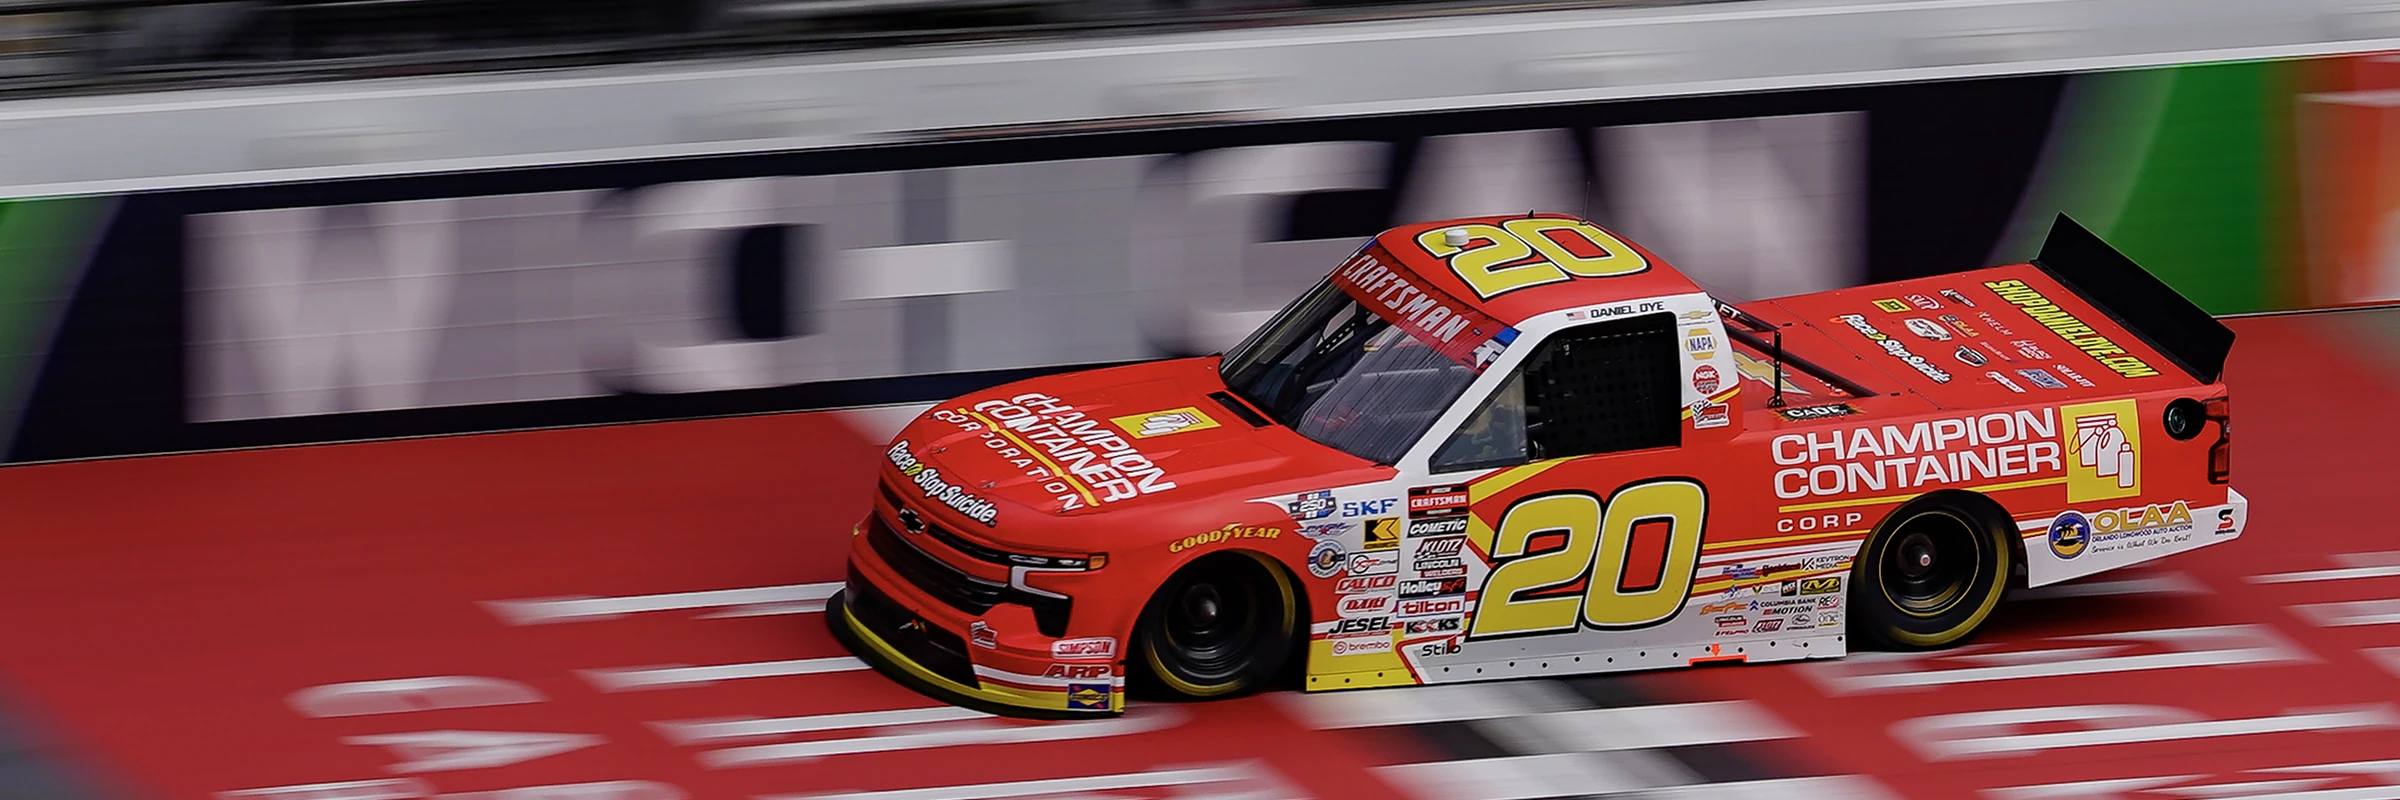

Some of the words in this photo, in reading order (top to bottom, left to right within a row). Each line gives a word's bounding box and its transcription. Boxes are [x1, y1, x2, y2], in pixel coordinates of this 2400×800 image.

[1414, 218, 1651, 301] 20
[1342, 254, 1470, 344] CRAFTSMAN
[1591, 304, 1636, 318] DANIEL
[1640, 301, 1664, 313] DYE
[1689, 336, 1714, 351] NAPA
[1695, 370, 1717, 380] NGK
[1012, 393, 1177, 495] CHAMPION
[1771, 407, 2057, 465] CHAMPION
[974, 400, 1138, 503] CONTAINER
[1774, 441, 2061, 499] CONTAINER
[887, 440, 916, 470] Race
[914, 468, 948, 497] Stop
[938, 486, 998, 523] Suicide
[1300, 498, 1327, 512] 250
[1342, 498, 1398, 517] SKF
[1411, 494, 1467, 508] CRAFTSMAN
[1777, 512, 1862, 533] CORP
[2094, 502, 2192, 531] OLAA
[1410, 518, 1467, 535] COMETIC
[2092, 533, 2119, 543] ORLANDO
[2120, 529, 2152, 540] LONGWOOD
[2152, 527, 2169, 535] AUTO
[2169, 524, 2193, 534] AUCTION
[1169, 522, 1281, 553] GOODYEAR
[1421, 539, 1463, 554] KLOTZ
[1416, 558, 1460, 570] LINCOLN
[1465, 477, 1708, 641] 20
[1815, 562, 1838, 570] MEDIA
[1338, 576, 1398, 591] CALICO
[1400, 580, 1442, 596] Holley
[1402, 600, 1460, 614] tilton
[1760, 599, 1796, 608] COLUMBIA
[1797, 597, 1817, 605] BANK
[1328, 616, 1392, 634] JESEL
[1405, 618, 1460, 635] KOOKS
[1057, 641, 1112, 655] SIMPSON
[1348, 641, 1390, 651] brembo
[1421, 636, 1462, 657] Stilo
[1044, 664, 1111, 678] ARP
